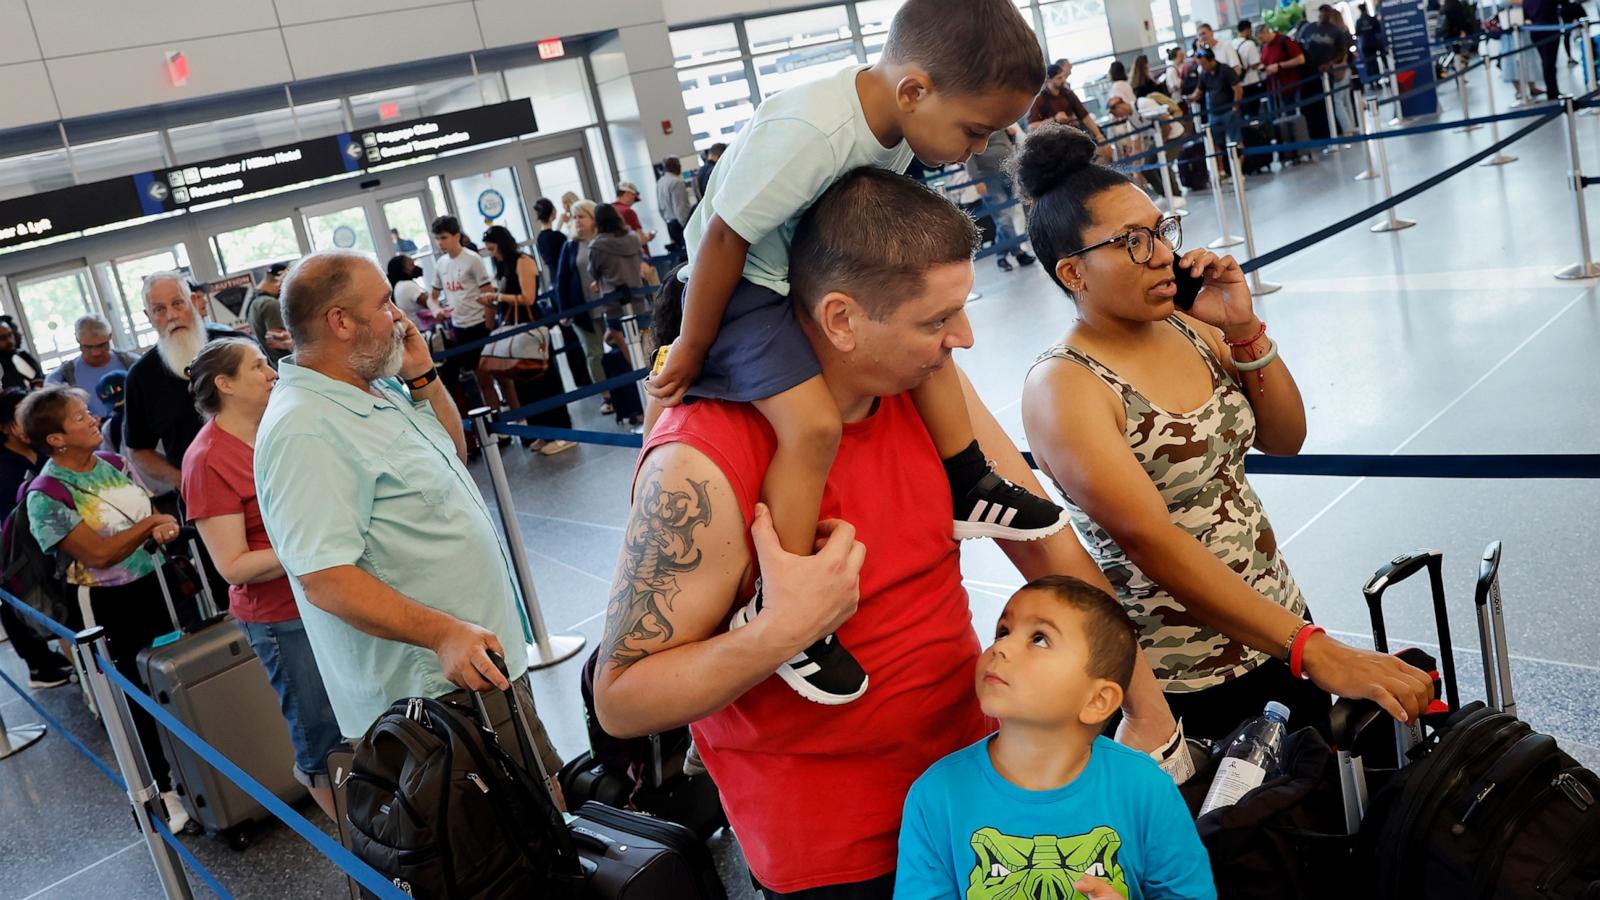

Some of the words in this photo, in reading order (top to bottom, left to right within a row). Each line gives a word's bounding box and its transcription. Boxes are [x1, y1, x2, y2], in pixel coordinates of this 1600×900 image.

[275, 149, 302, 164] Hotel
[17, 224, 28, 235] &
[27, 219, 52, 234] Lyft
[446, 280, 465, 292] AIA
